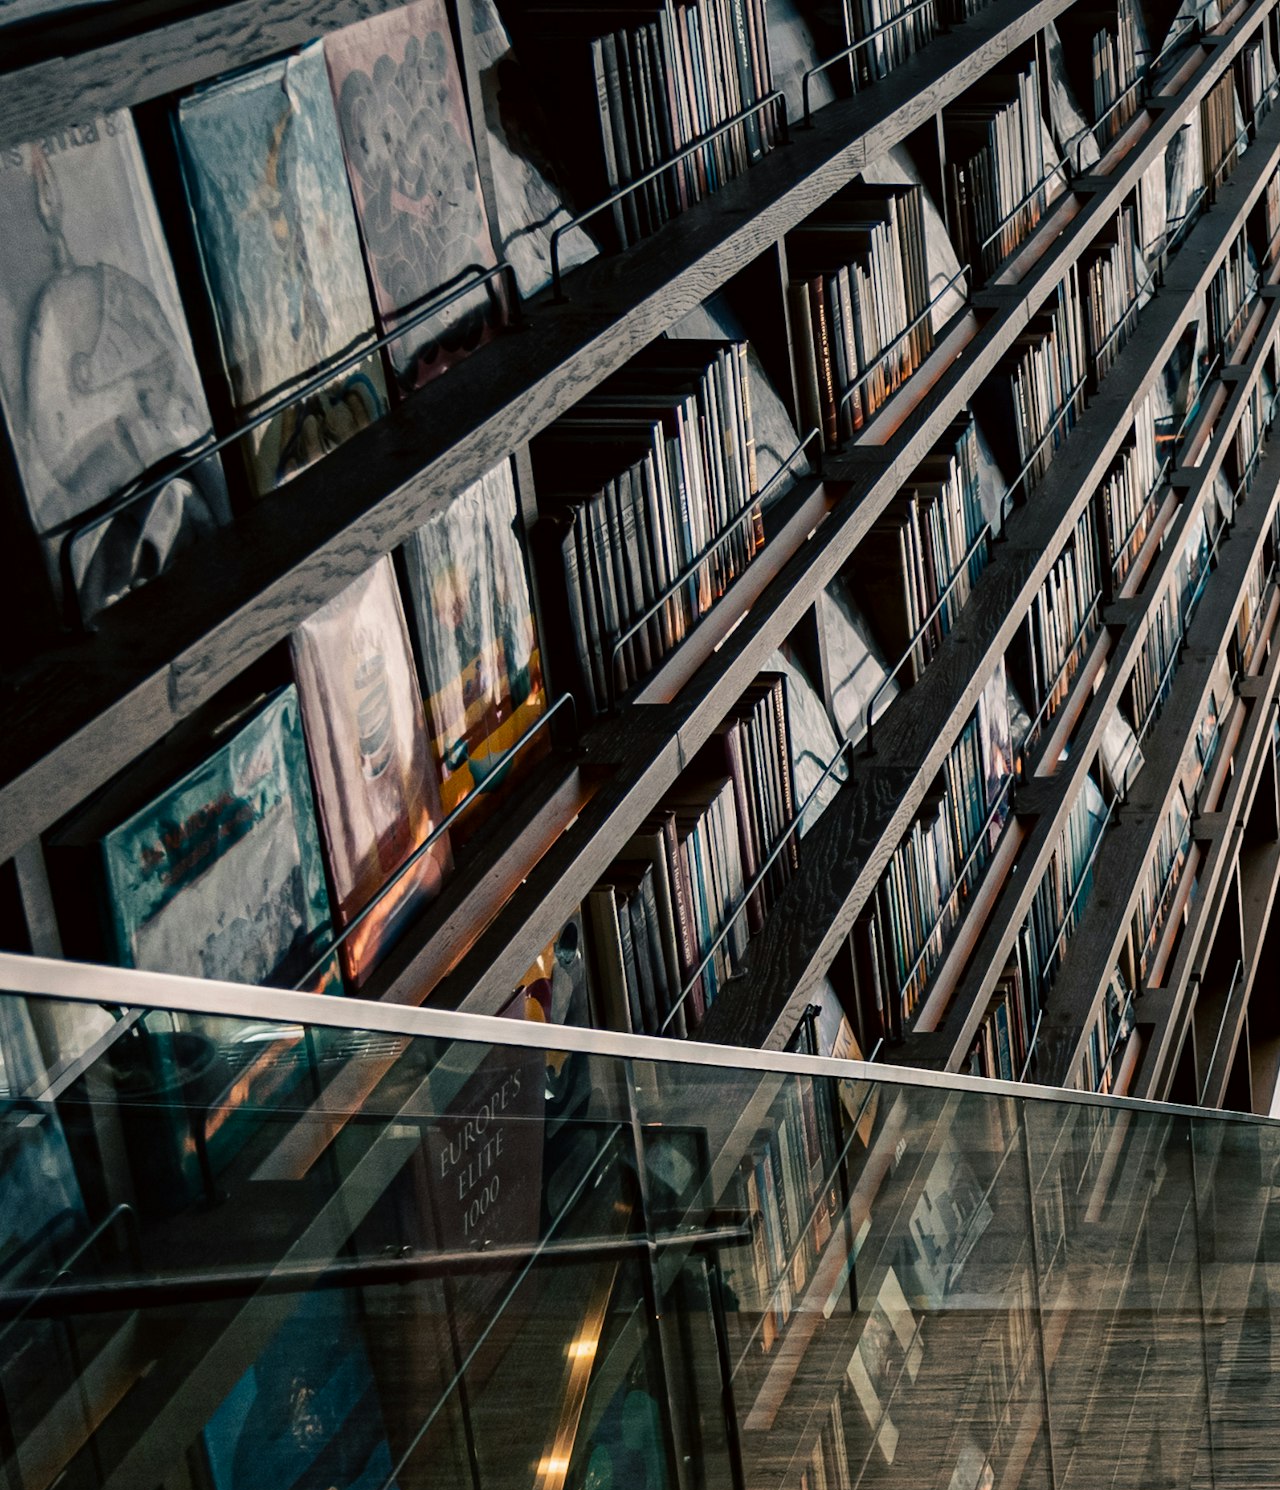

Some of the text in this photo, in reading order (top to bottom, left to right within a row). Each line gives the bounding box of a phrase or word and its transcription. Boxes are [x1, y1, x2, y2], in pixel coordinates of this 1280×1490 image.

[440, 1068, 522, 1179] EUROPE'S
[458, 1127, 504, 1202] ELITE
[463, 1174, 501, 1236] 1000
